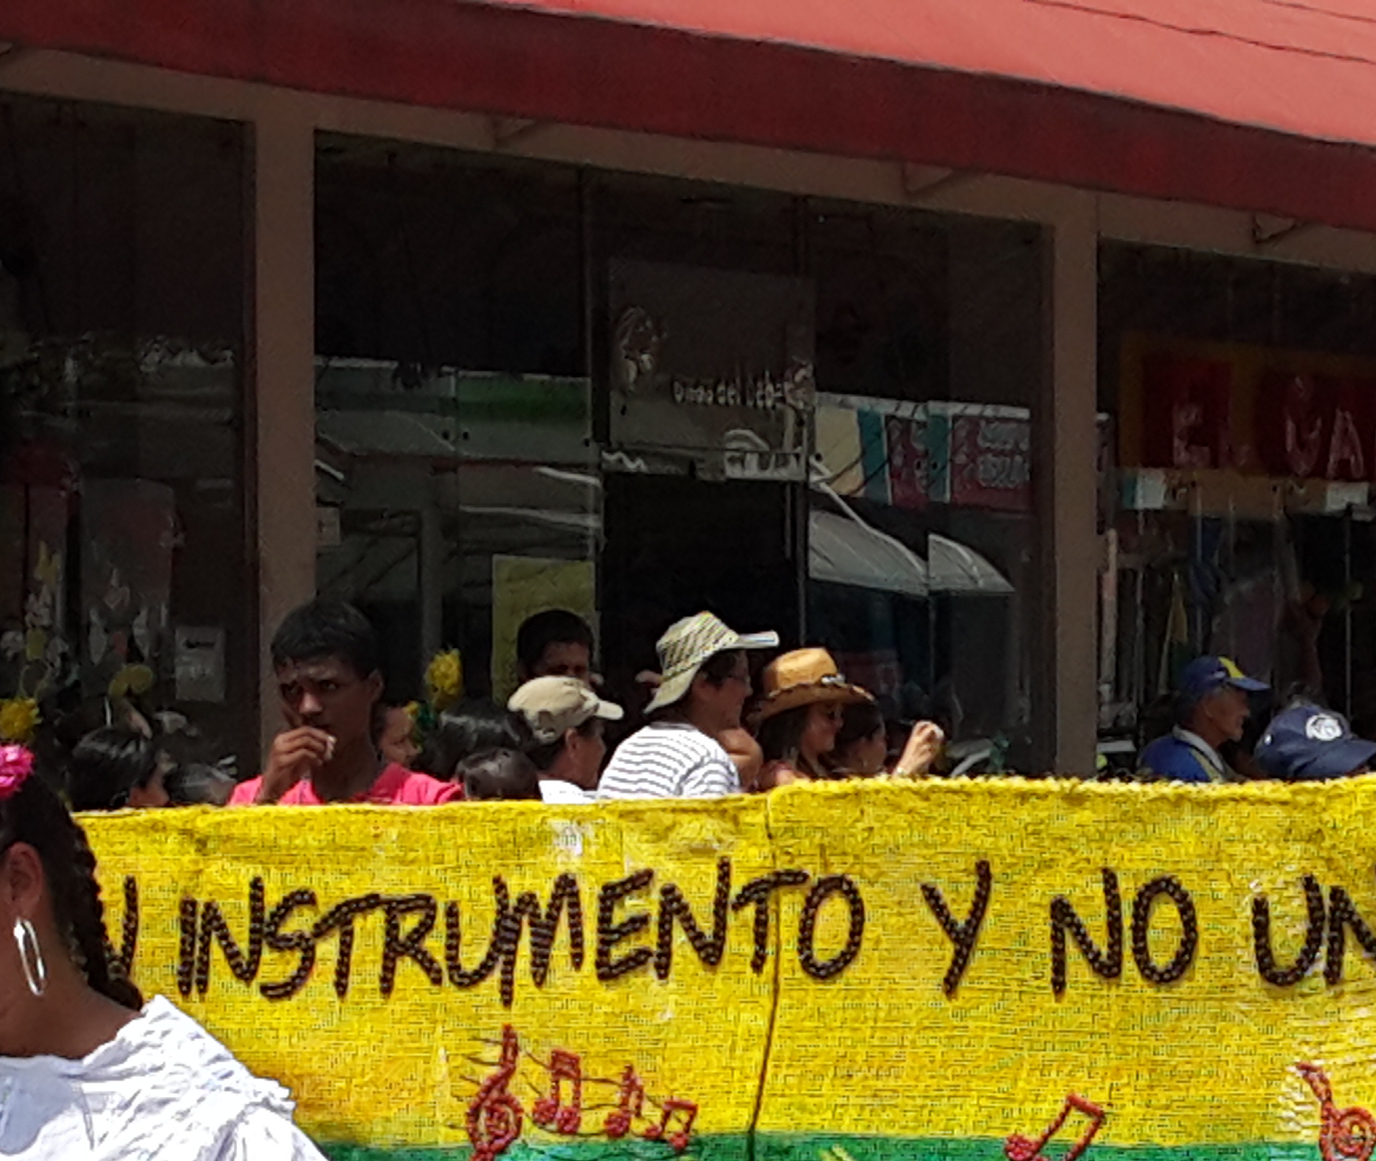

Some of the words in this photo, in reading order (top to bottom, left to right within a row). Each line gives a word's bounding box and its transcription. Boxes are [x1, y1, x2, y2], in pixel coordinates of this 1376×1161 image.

[176, 856, 867, 1009] INSTRUMENTO
[921, 859, 993, 999] Y
[1049, 867, 1202, 1000] NO
